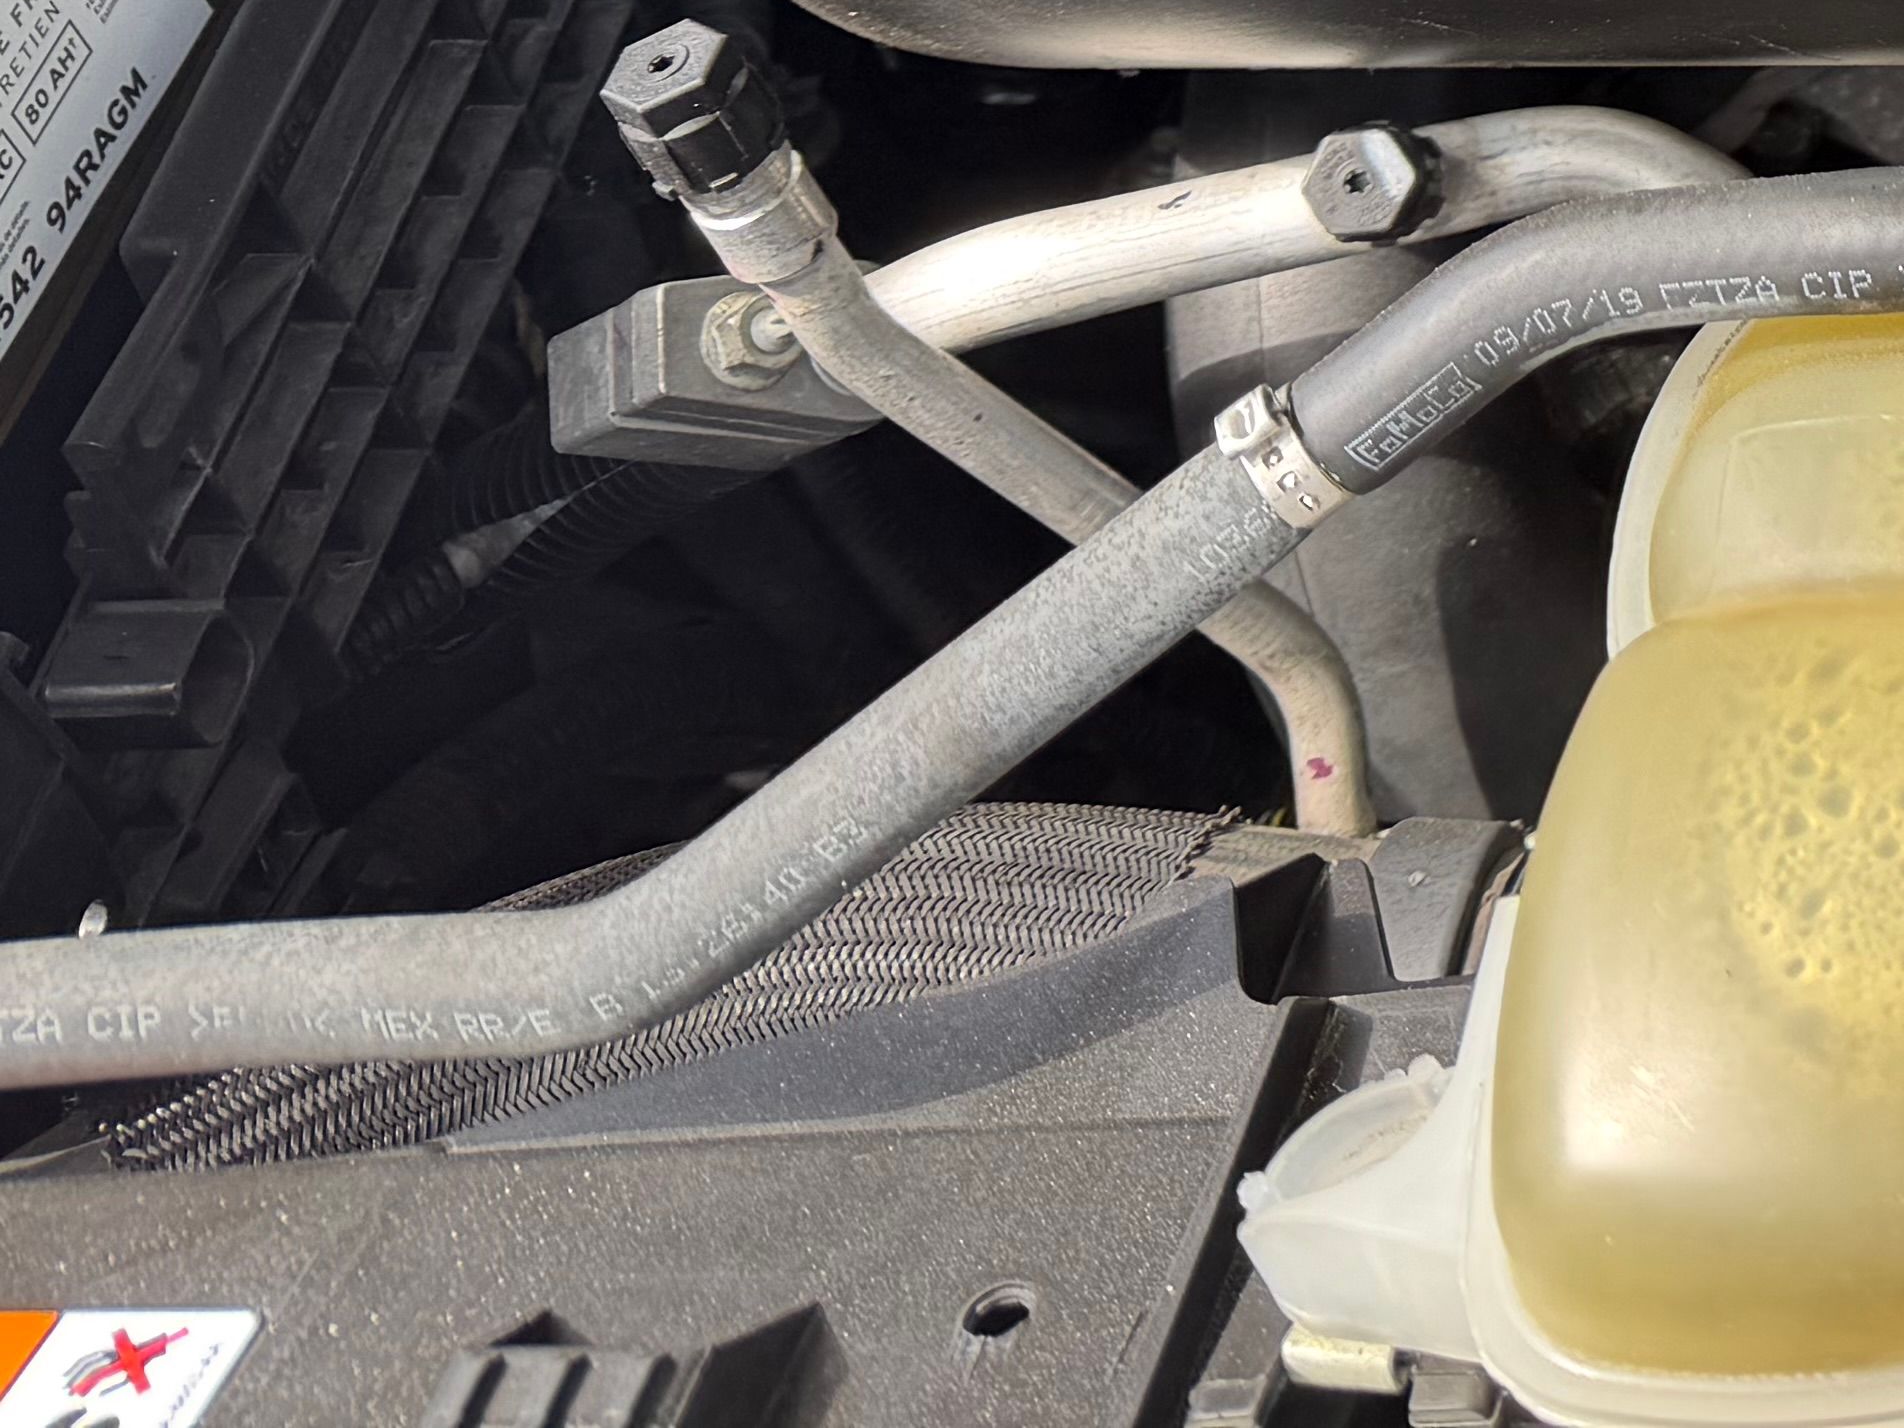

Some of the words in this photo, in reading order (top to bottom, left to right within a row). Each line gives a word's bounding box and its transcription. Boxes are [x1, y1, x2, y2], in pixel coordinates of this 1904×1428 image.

[0, 0, 60, 94] RETIEN
[25, 88, 50, 126] 80
[46, 67, 148, 234] 94RAGM
[1473, 286, 1644, 369] 09/07/19
[1801, 269, 1873, 301] CIP
[87, 1007, 161, 1041] CIP
[361, 1006, 439, 1041] MEX
